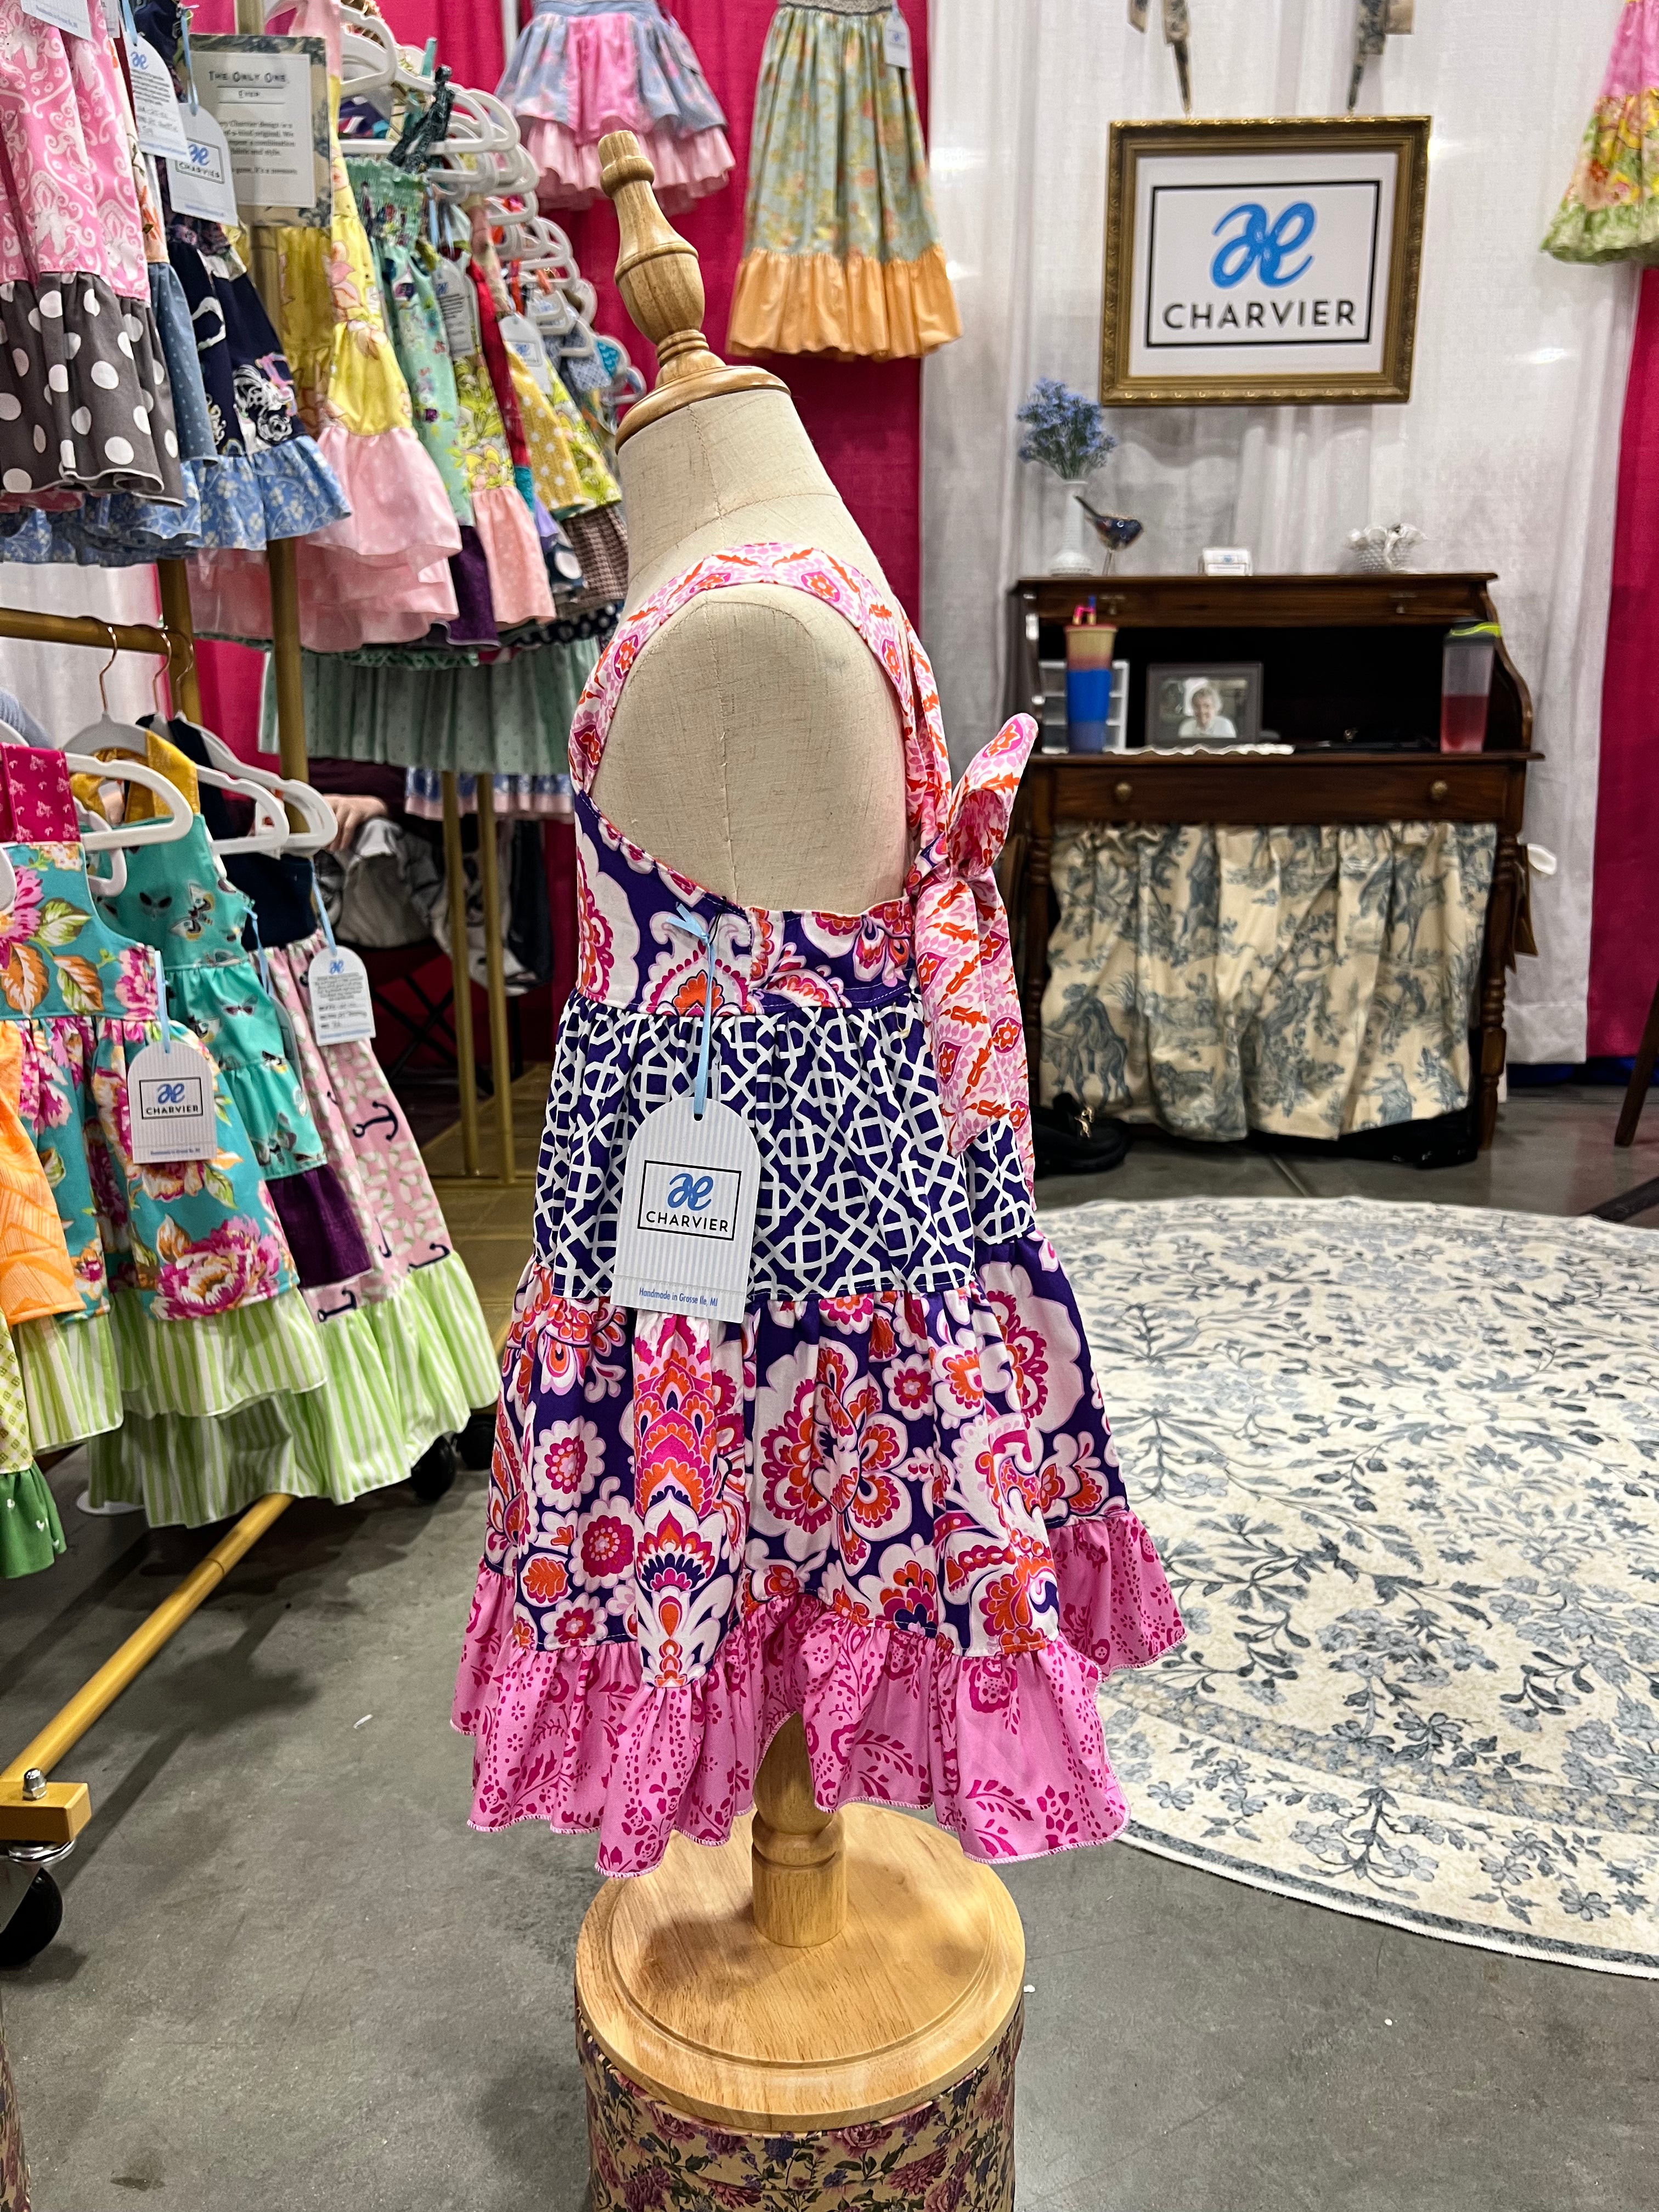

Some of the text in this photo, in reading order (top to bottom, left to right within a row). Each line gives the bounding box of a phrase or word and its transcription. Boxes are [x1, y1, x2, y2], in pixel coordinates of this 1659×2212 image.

[1163, 300, 1356, 330] CHARVIER
[146, 1104, 199, 1115] CHARVIER
[646, 1210, 729, 1232] CHARVIER
[639, 1287, 670, 1300] Handmade
[672, 1292, 678, 1301] in
[679, 1293, 698, 1304] Grosse
[710, 1297, 718, 1307] MI
